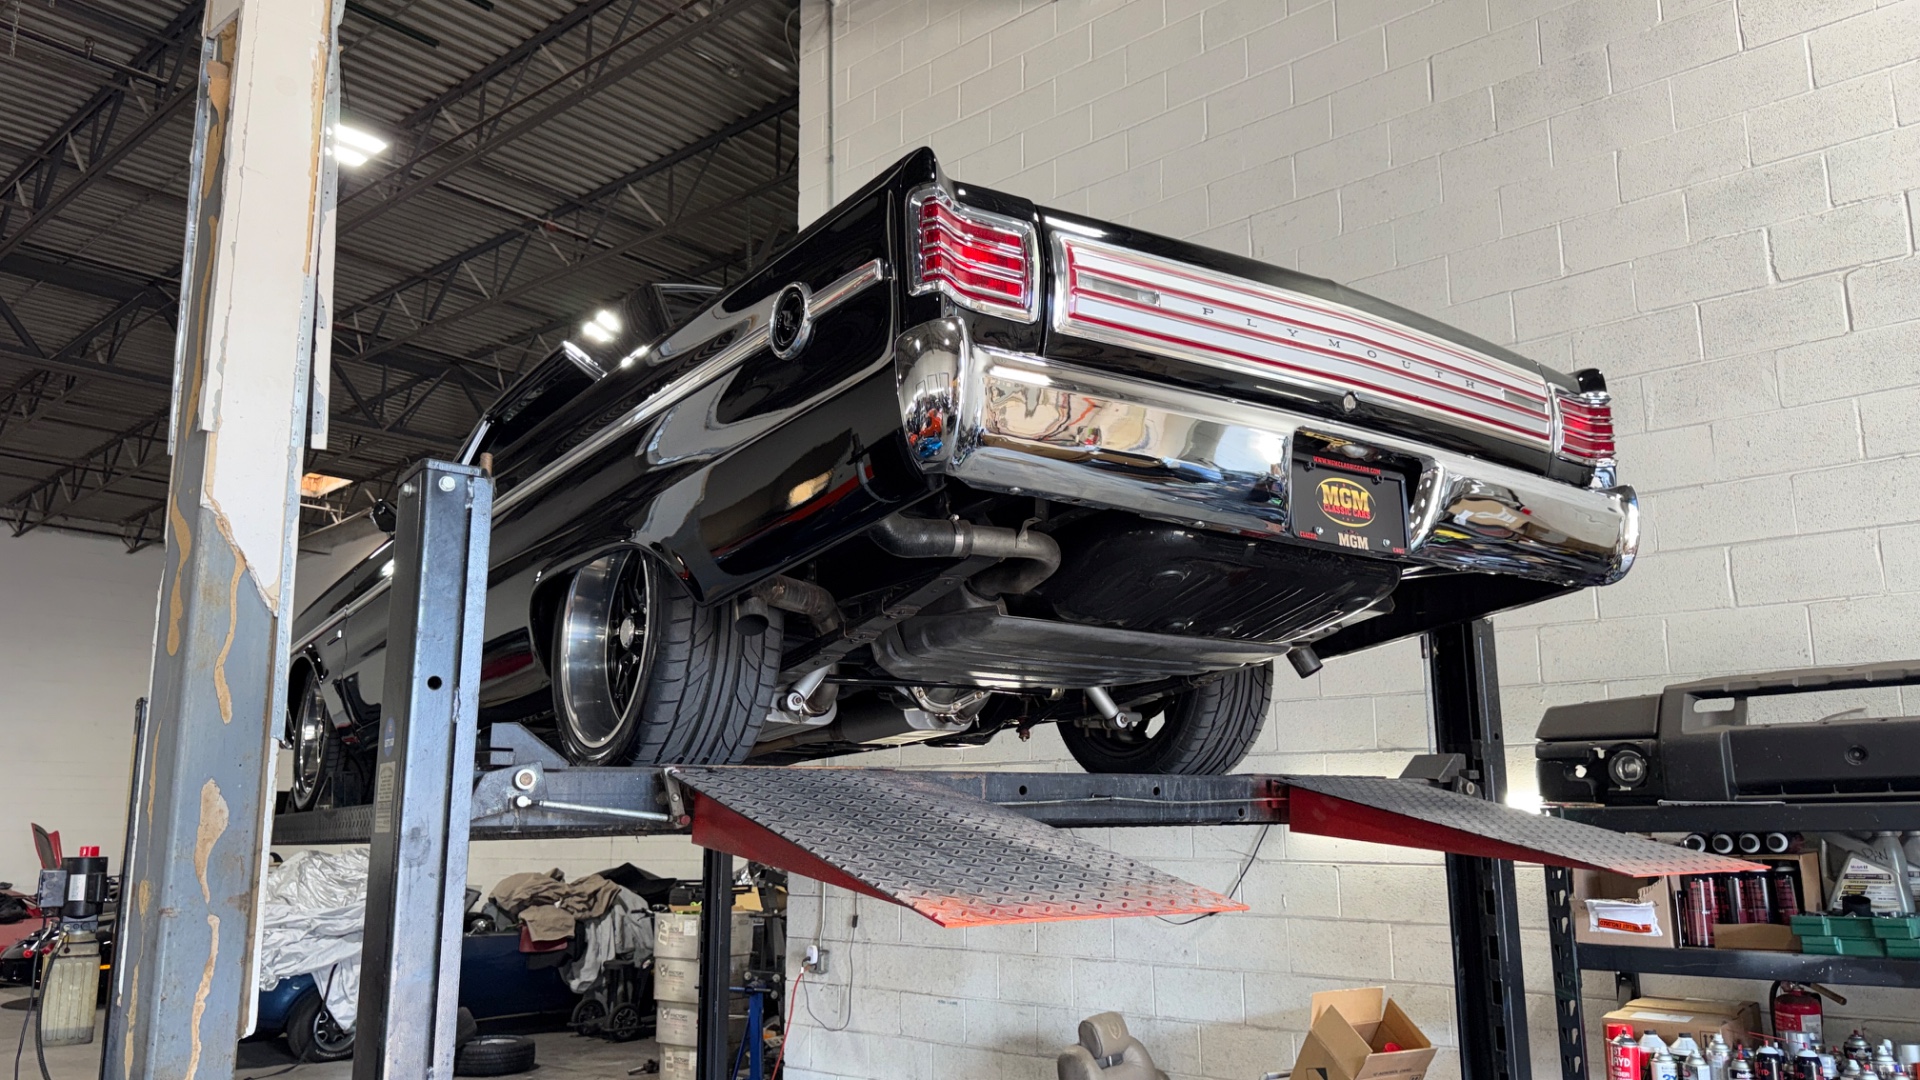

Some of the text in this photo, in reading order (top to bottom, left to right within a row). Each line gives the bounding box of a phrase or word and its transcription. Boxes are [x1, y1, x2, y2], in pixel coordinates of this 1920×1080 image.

[1202, 306, 1475, 389] PLYMOUTH
[1320, 484, 1370, 512] MGM
[1323, 503, 1371, 519] CLASSIC CARS
[1338, 532, 1369, 550] MGM
